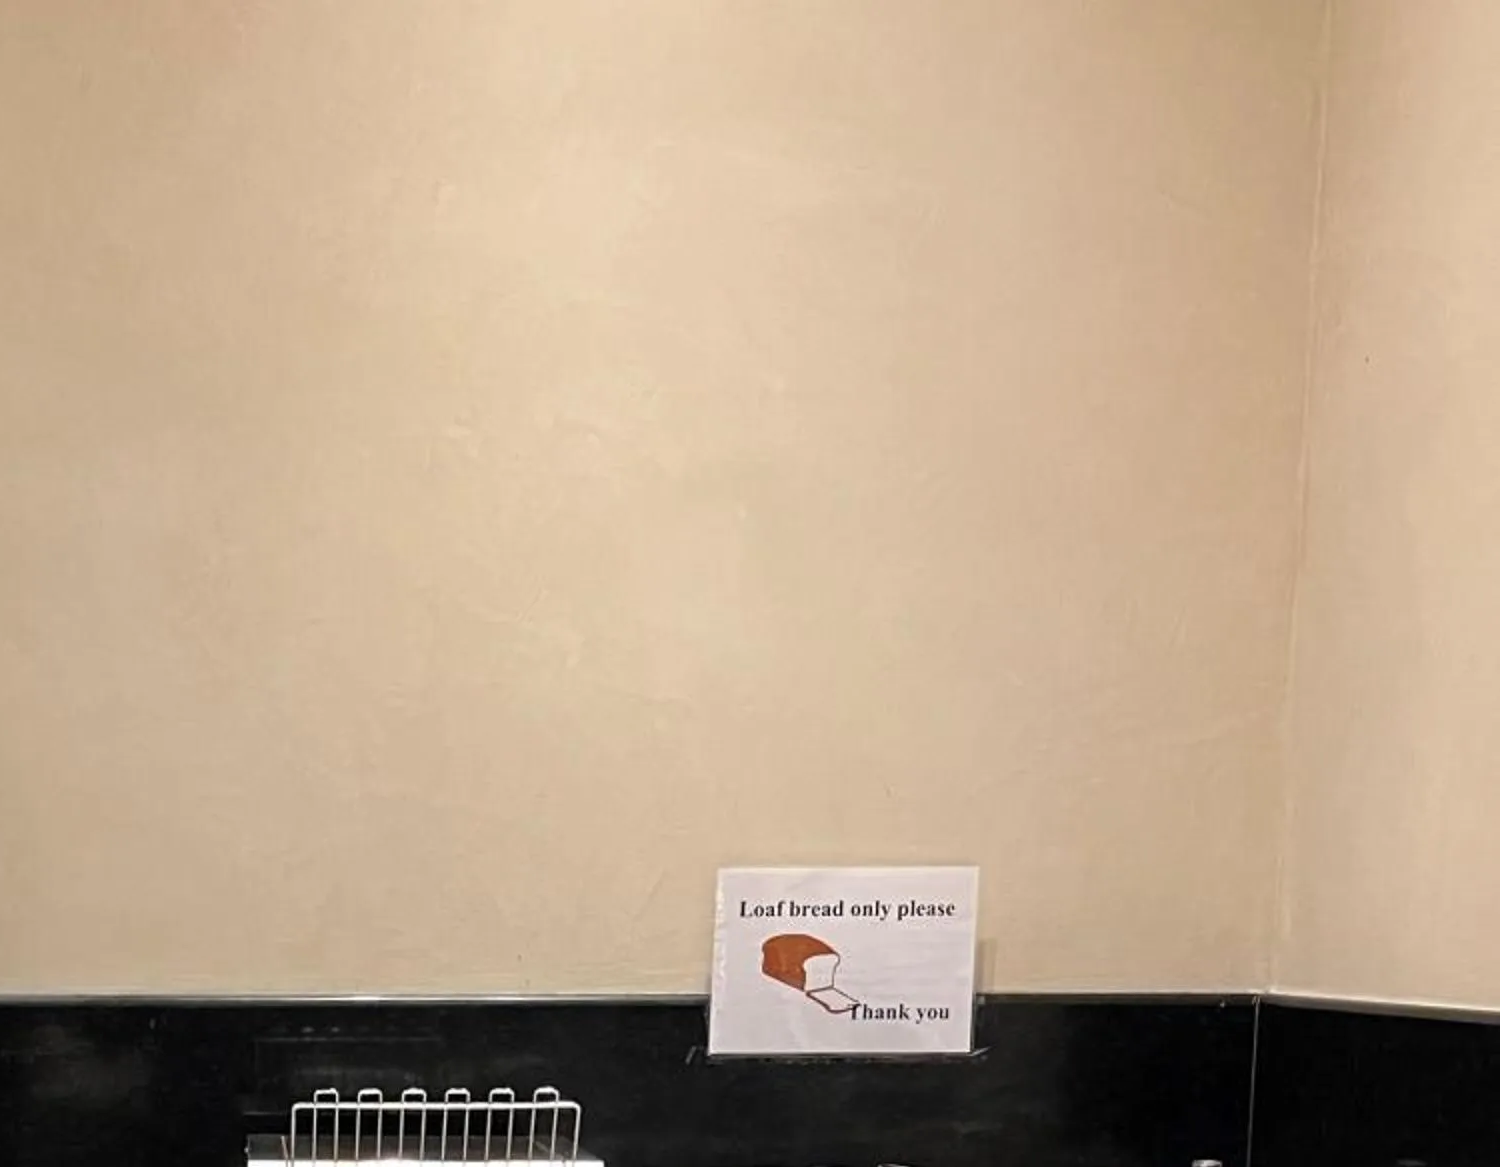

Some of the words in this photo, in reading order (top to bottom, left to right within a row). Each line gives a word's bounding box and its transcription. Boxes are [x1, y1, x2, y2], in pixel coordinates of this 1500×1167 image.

[739, 900, 784, 918] Loaf
[789, 900, 844, 918] bread
[851, 900, 892, 922] only
[897, 900, 957, 922] please
[848, 1003, 910, 1021] Thank
[916, 1006, 950, 1025] you
